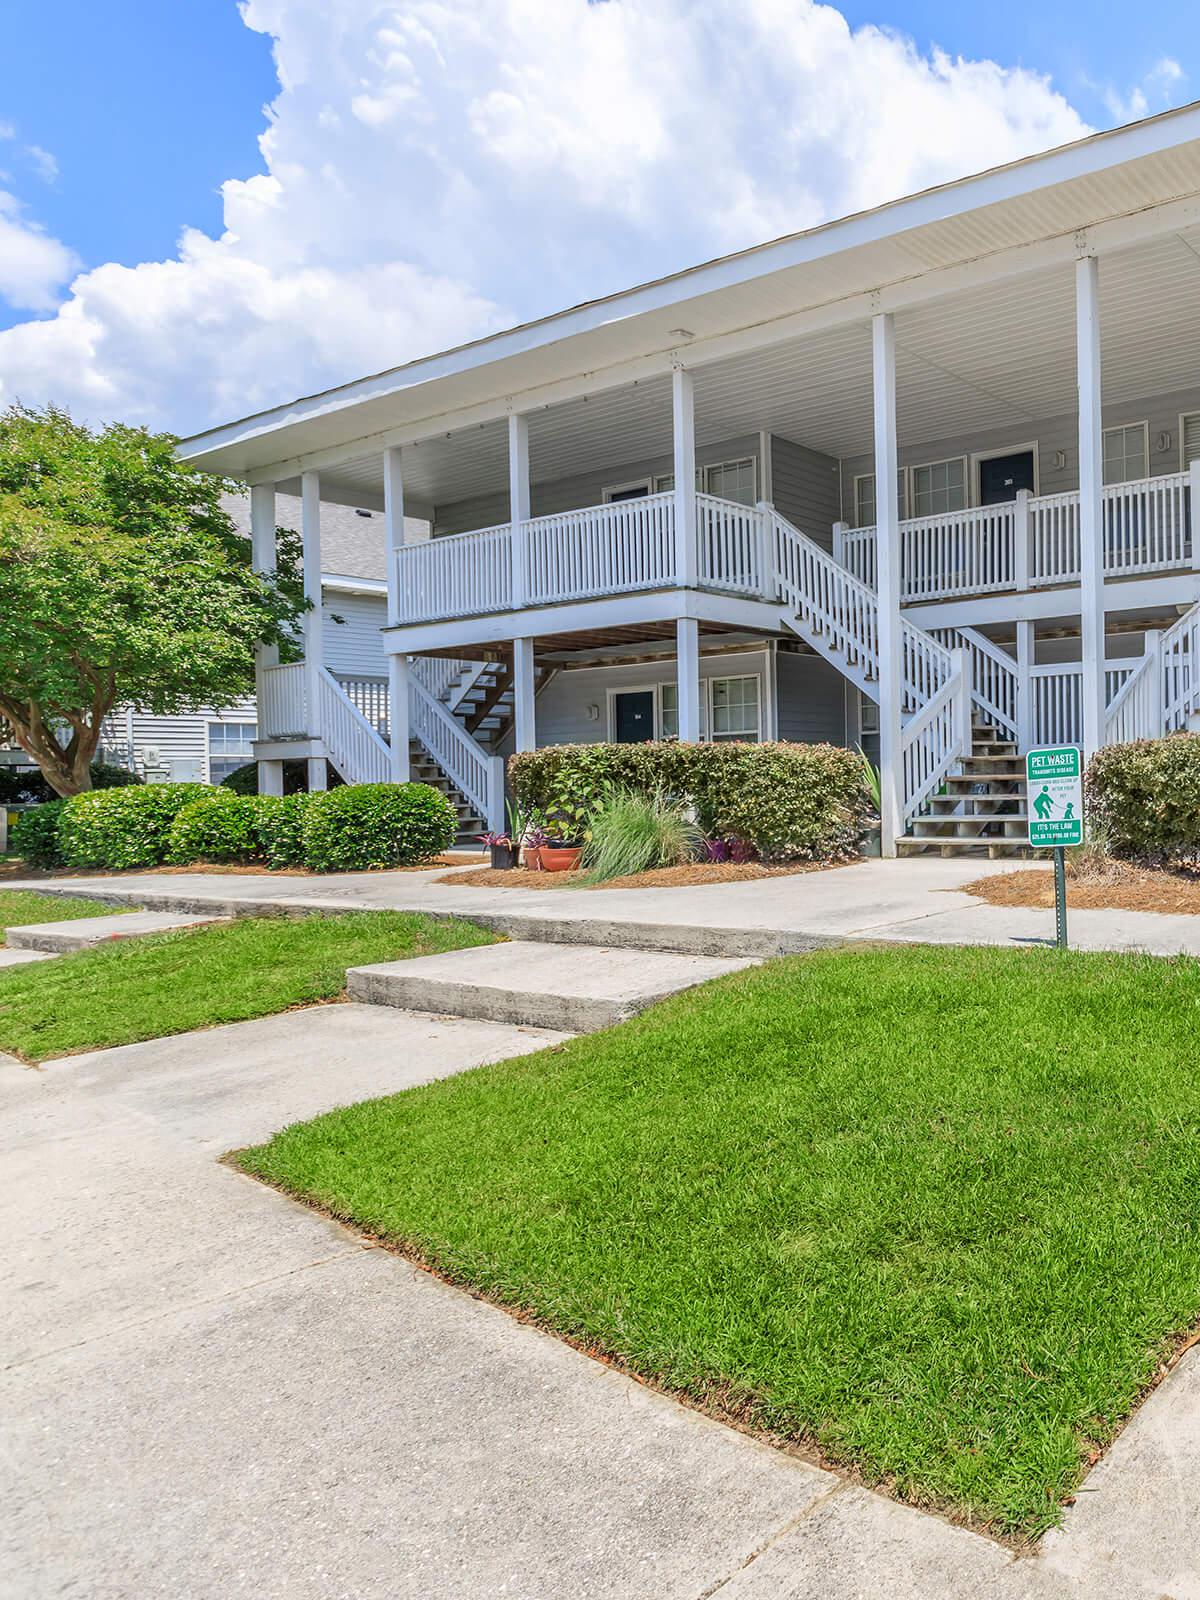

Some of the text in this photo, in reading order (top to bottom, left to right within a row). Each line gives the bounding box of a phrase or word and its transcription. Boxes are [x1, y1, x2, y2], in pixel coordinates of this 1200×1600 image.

[1032, 753, 1075, 767] PET WASTE
[1037, 823, 1049, 831] IT'S
[1060, 822, 1073, 830] LAW
